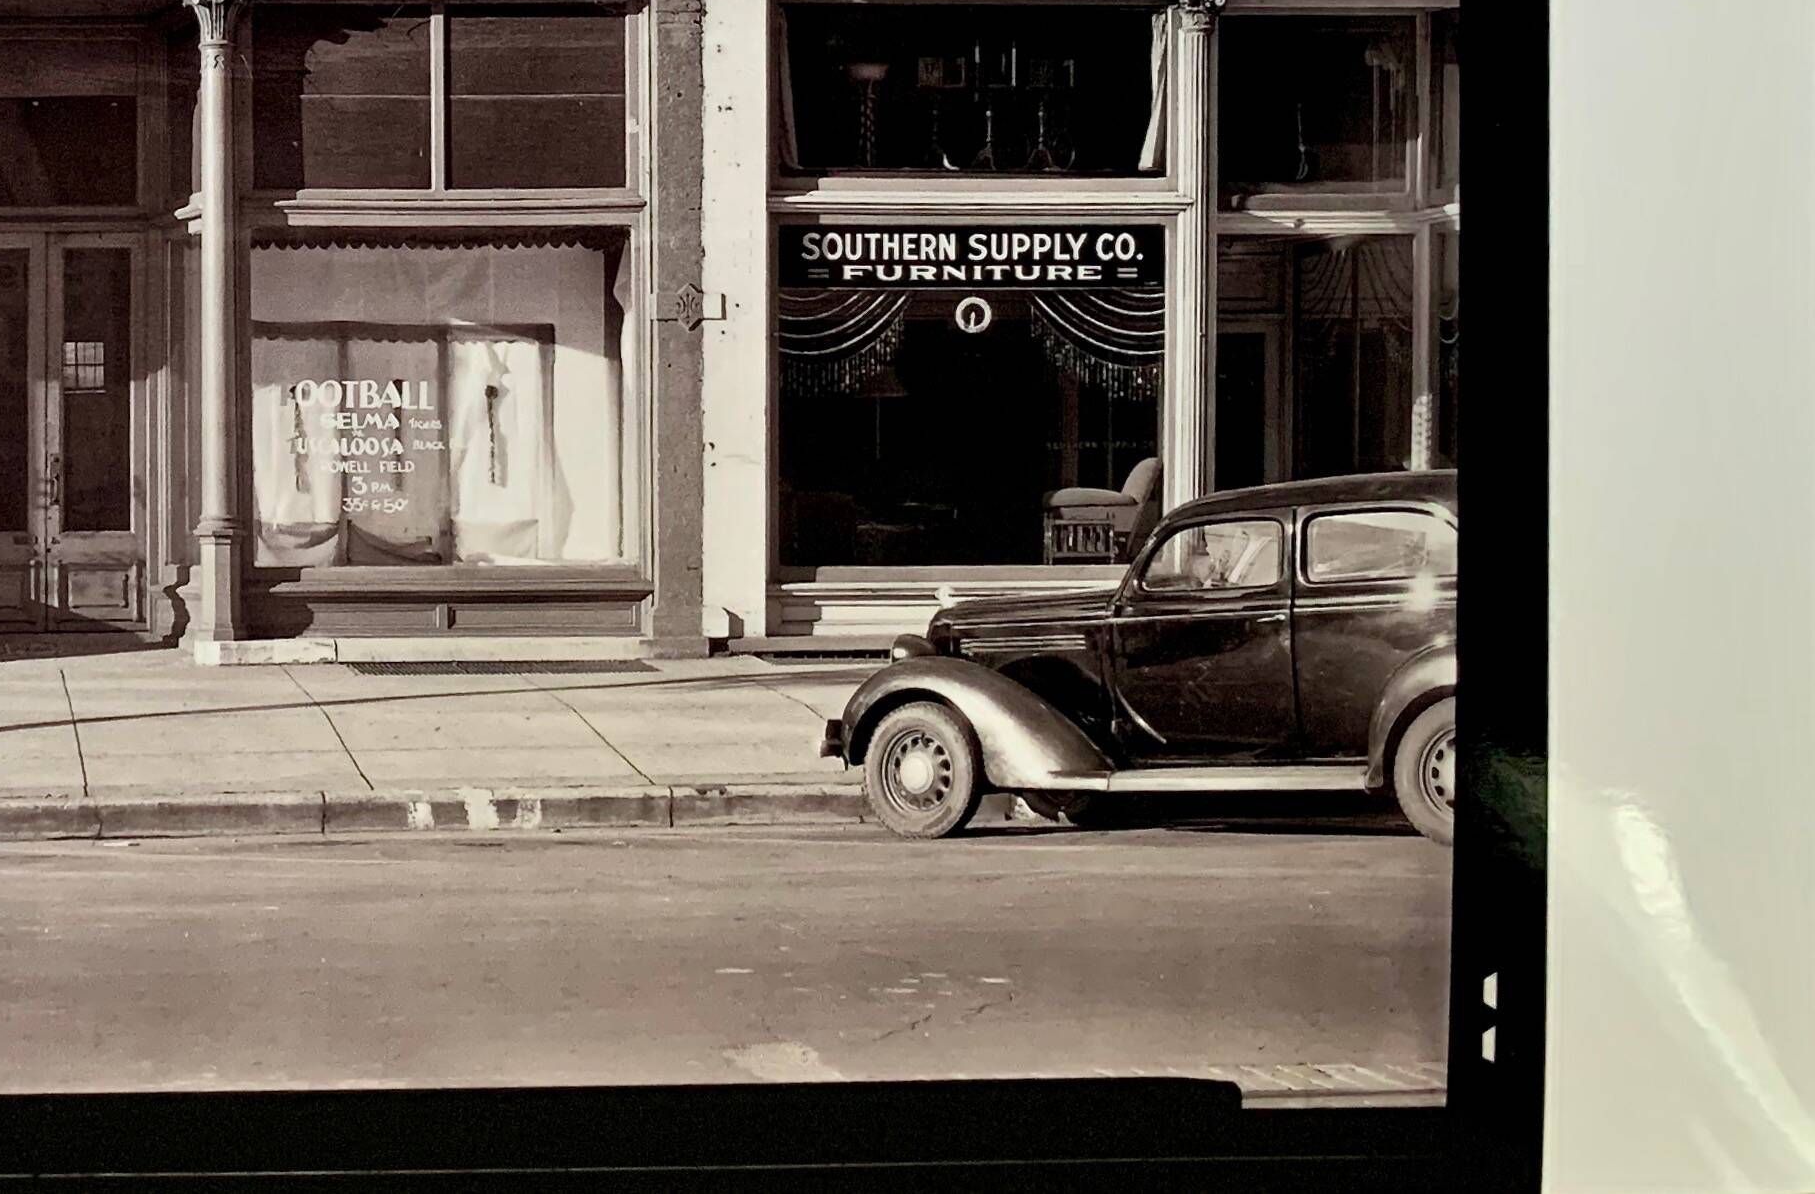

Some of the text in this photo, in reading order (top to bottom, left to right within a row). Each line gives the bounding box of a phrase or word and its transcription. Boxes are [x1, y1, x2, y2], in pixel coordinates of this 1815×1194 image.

[801, 231, 1145, 261] SOUTHERN SUPPLY CO.
[842, 265, 1103, 281] FURNITURE
[379, 460, 415, 474] FIELD
[351, 476, 368, 495] 3
